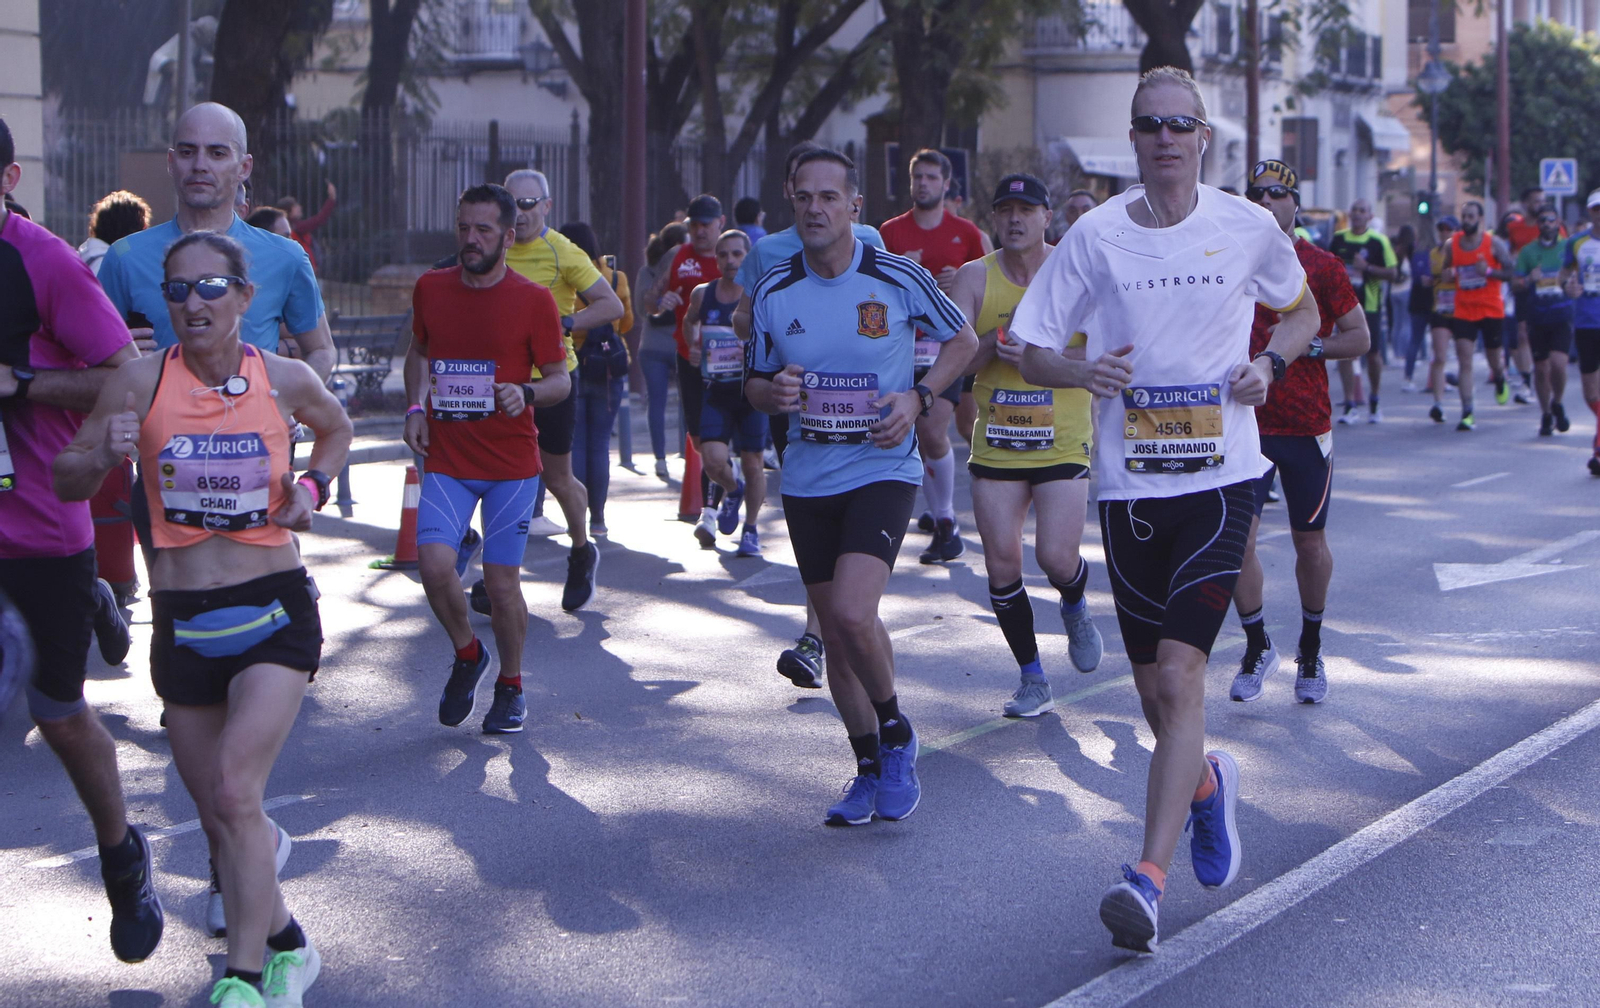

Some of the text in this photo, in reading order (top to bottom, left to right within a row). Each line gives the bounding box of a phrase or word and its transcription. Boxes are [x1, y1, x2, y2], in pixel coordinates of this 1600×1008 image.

[785, 328, 806, 336] adidas
[447, 363, 487, 373] ZURICH
[821, 377, 868, 388] ZURICH
[447, 385, 474, 396] 7456
[1007, 394, 1045, 403] ZURICH
[1153, 390, 1208, 404] ZURICH
[822, 402, 854, 414] 8135
[800, 417, 833, 429] ANDRES
[1006, 415, 1033, 425] 4594
[988, 427, 1052, 438] ESTEBAN&FAMILY
[1155, 421, 1193, 436] 4566
[197, 439, 259, 454] ZURICH
[1132, 441, 1217, 455] JOSÉ ARMANDO
[197, 476, 241, 490] 8528
[200, 497, 237, 511] CHARI
